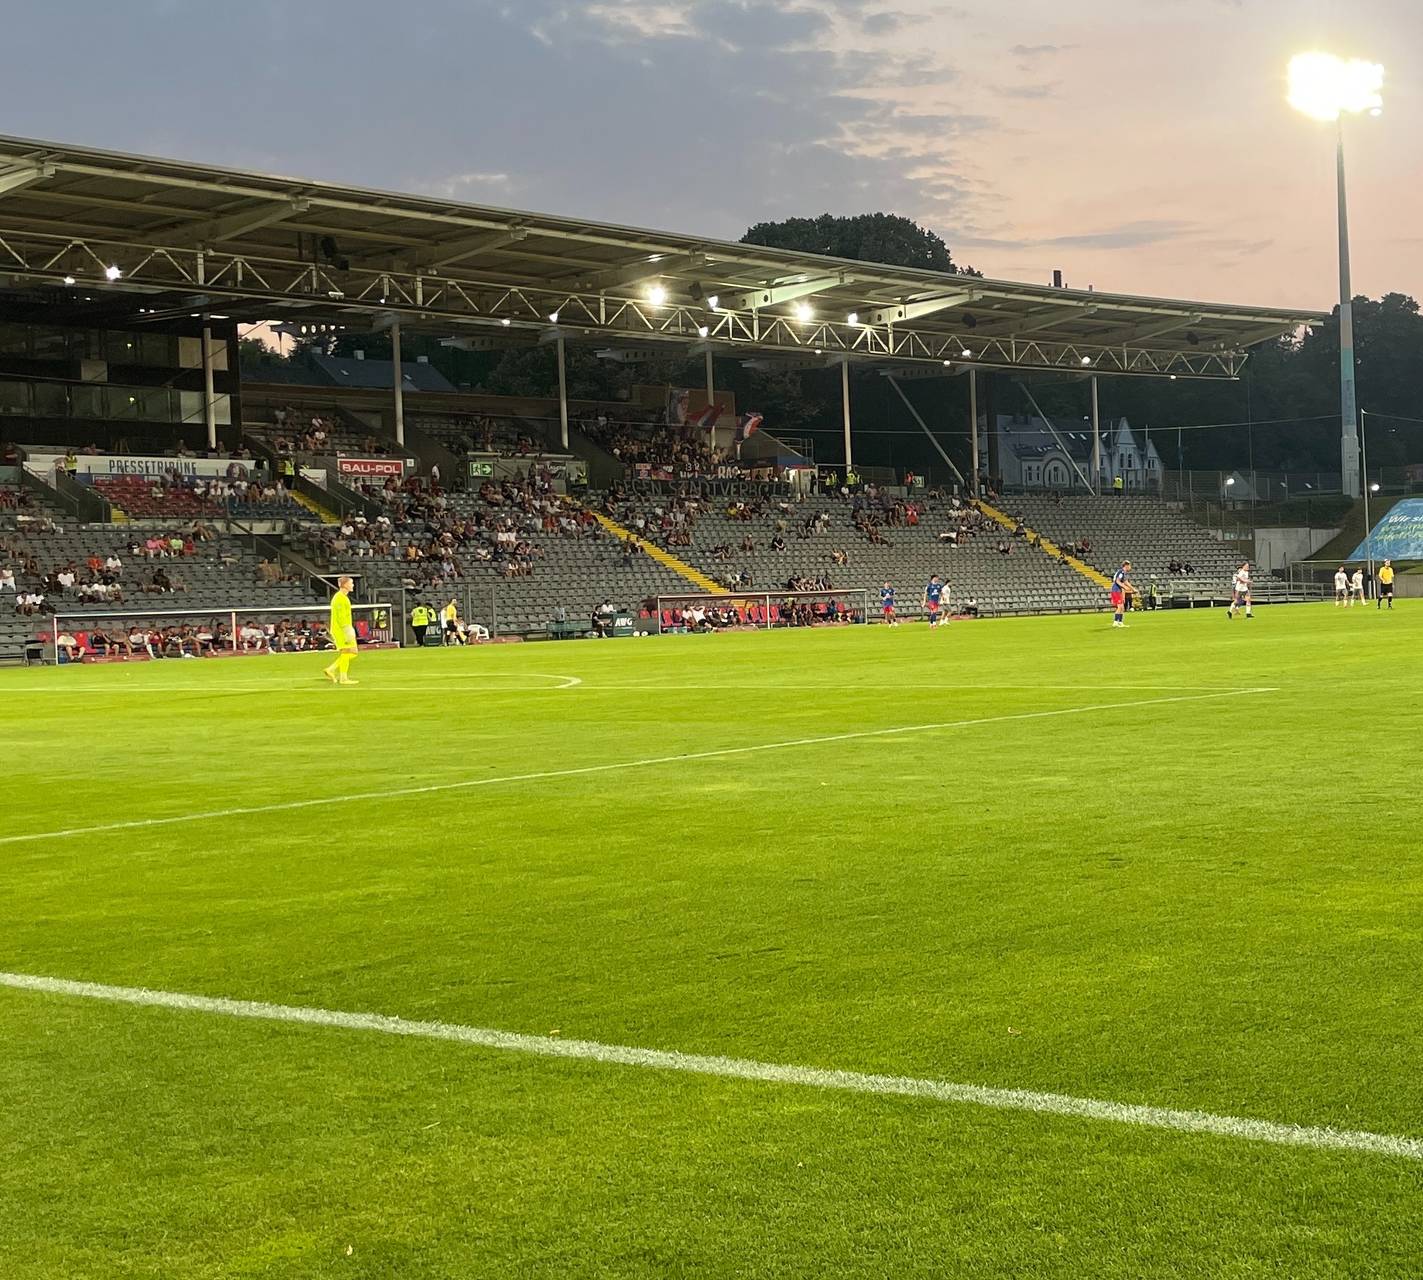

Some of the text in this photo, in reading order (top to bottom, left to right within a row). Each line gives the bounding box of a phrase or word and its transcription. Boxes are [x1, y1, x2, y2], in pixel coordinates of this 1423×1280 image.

[109, 459, 197, 475] PRESSETRIBÜNE
[342, 463, 400, 474] BAU-POL
[1388, 513, 1410, 523] Wir
